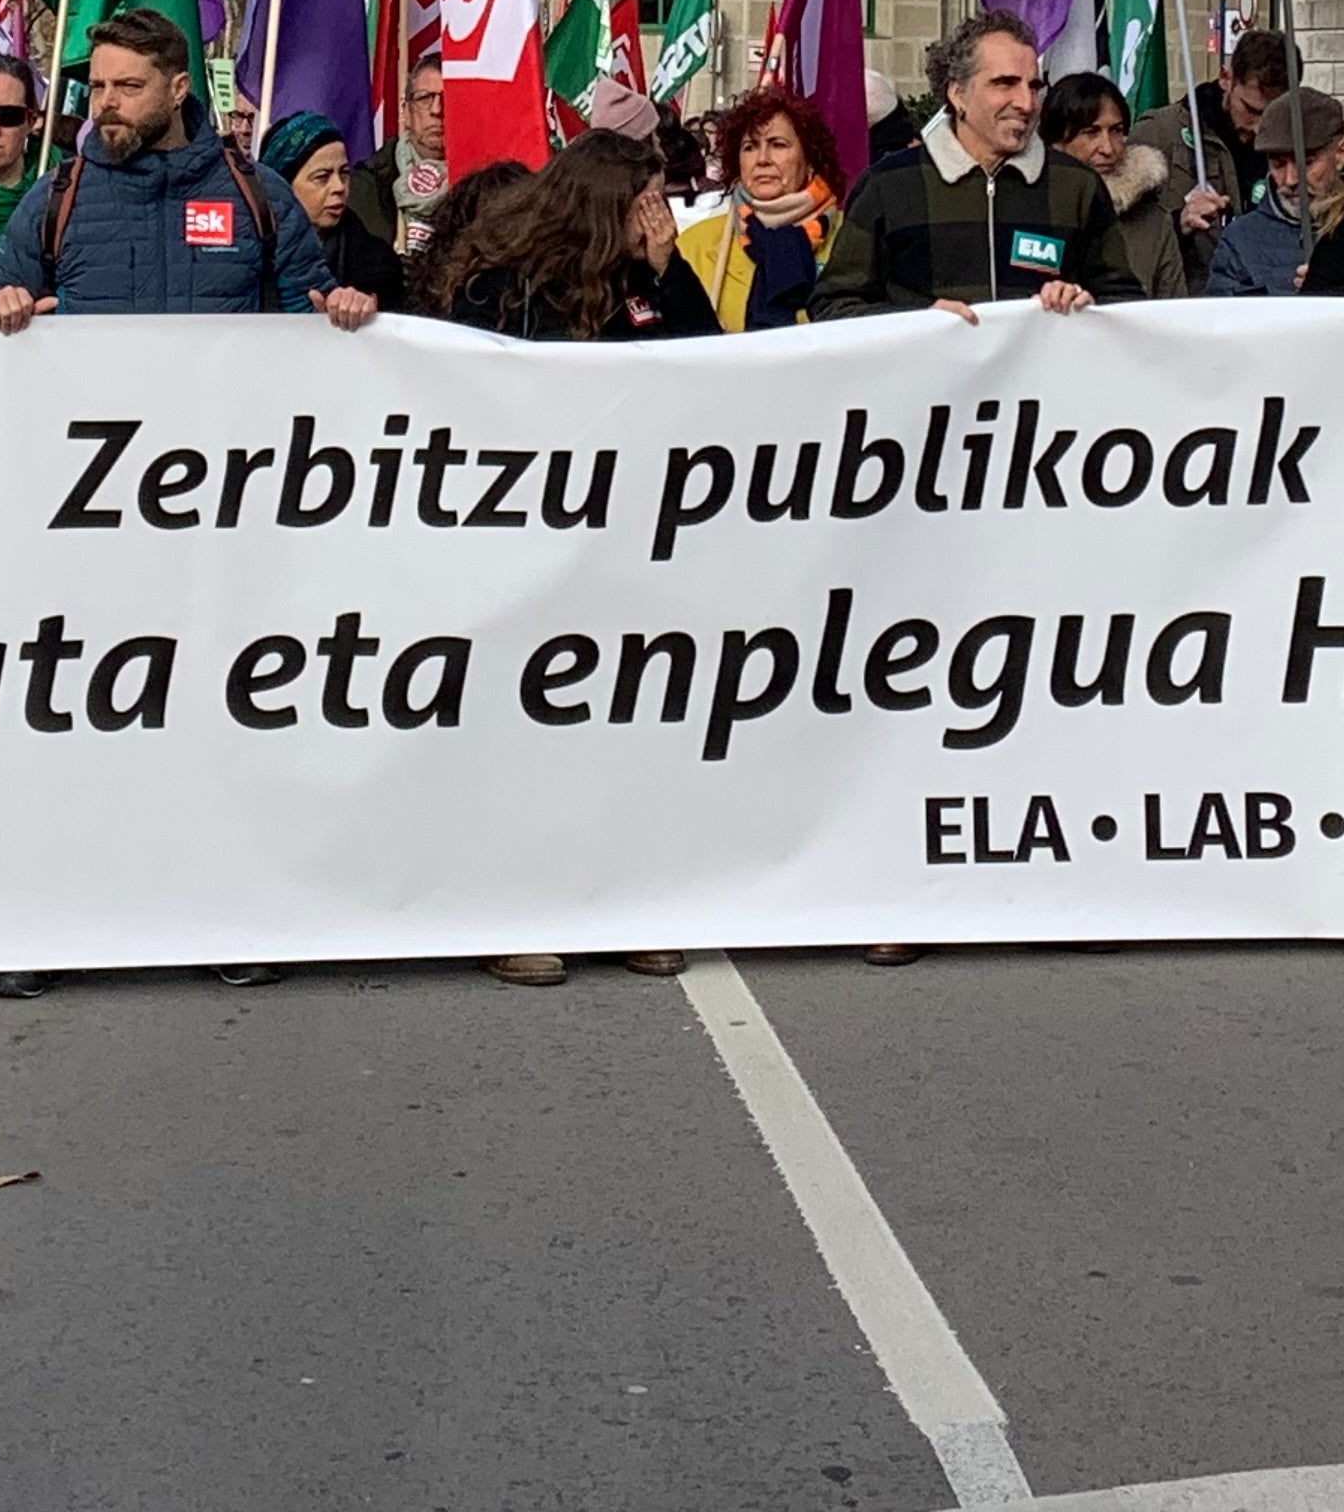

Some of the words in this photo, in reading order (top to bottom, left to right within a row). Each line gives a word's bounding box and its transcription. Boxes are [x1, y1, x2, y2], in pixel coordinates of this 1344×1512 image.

[185, 208, 226, 233] Esk
[1018, 237, 1057, 263] ELA
[48, 414, 617, 530] Zerbitzu
[651, 396, 1320, 562] publikoak
[226, 611, 472, 730] eta
[520, 588, 1231, 762] enplegua
[926, 792, 1070, 865] ELA
[1145, 790, 1295, 861] LAB
